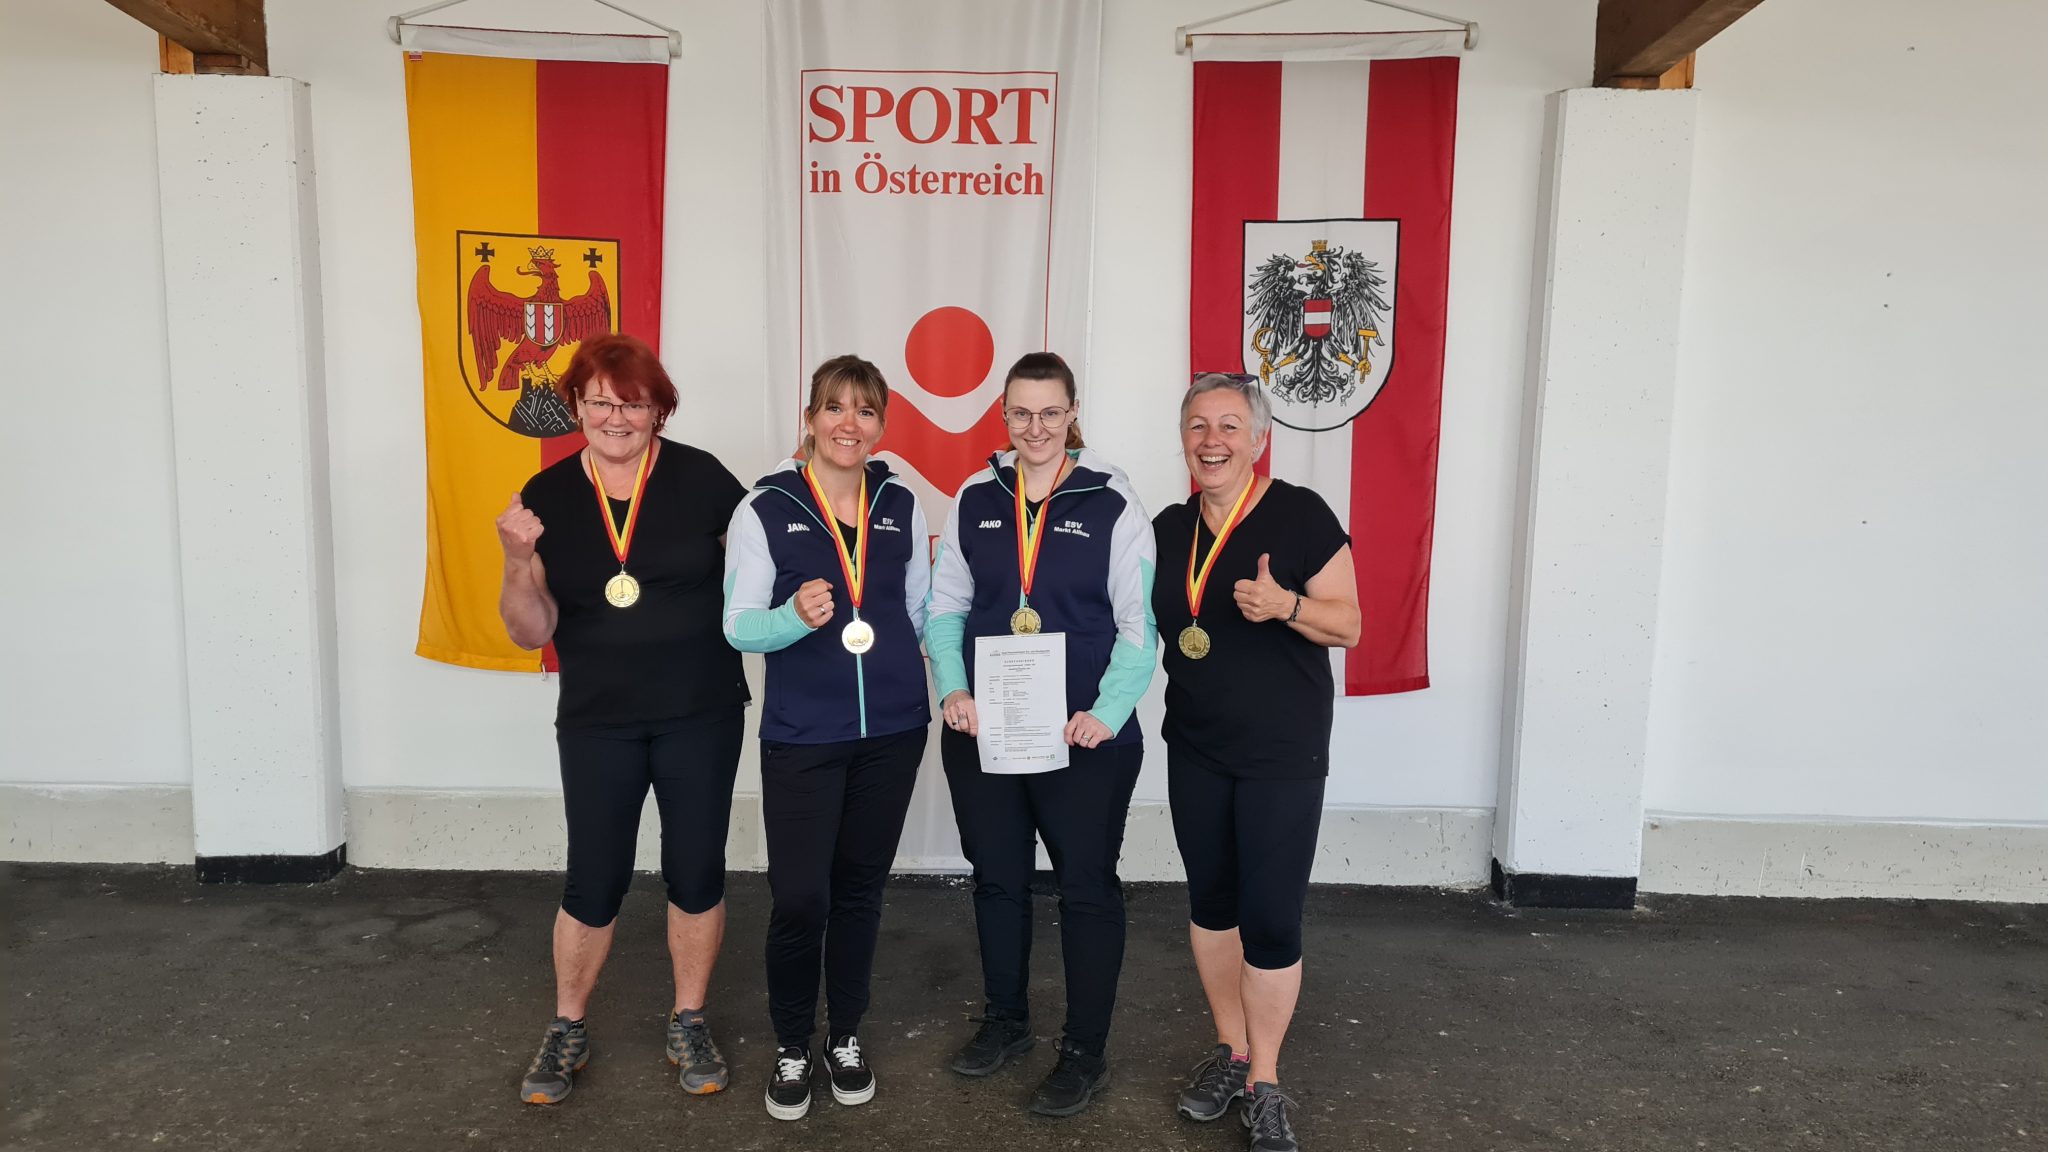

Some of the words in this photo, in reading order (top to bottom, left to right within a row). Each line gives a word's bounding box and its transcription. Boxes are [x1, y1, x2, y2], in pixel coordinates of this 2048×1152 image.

[809, 85, 1049, 145] SPORT
[809, 161, 842, 193] in
[855, 152, 1044, 195] Österreich
[978, 520, 1002, 529] JAKO
[1064, 520, 1083, 529] ESV
[1053, 526, 1071, 534] Markt
